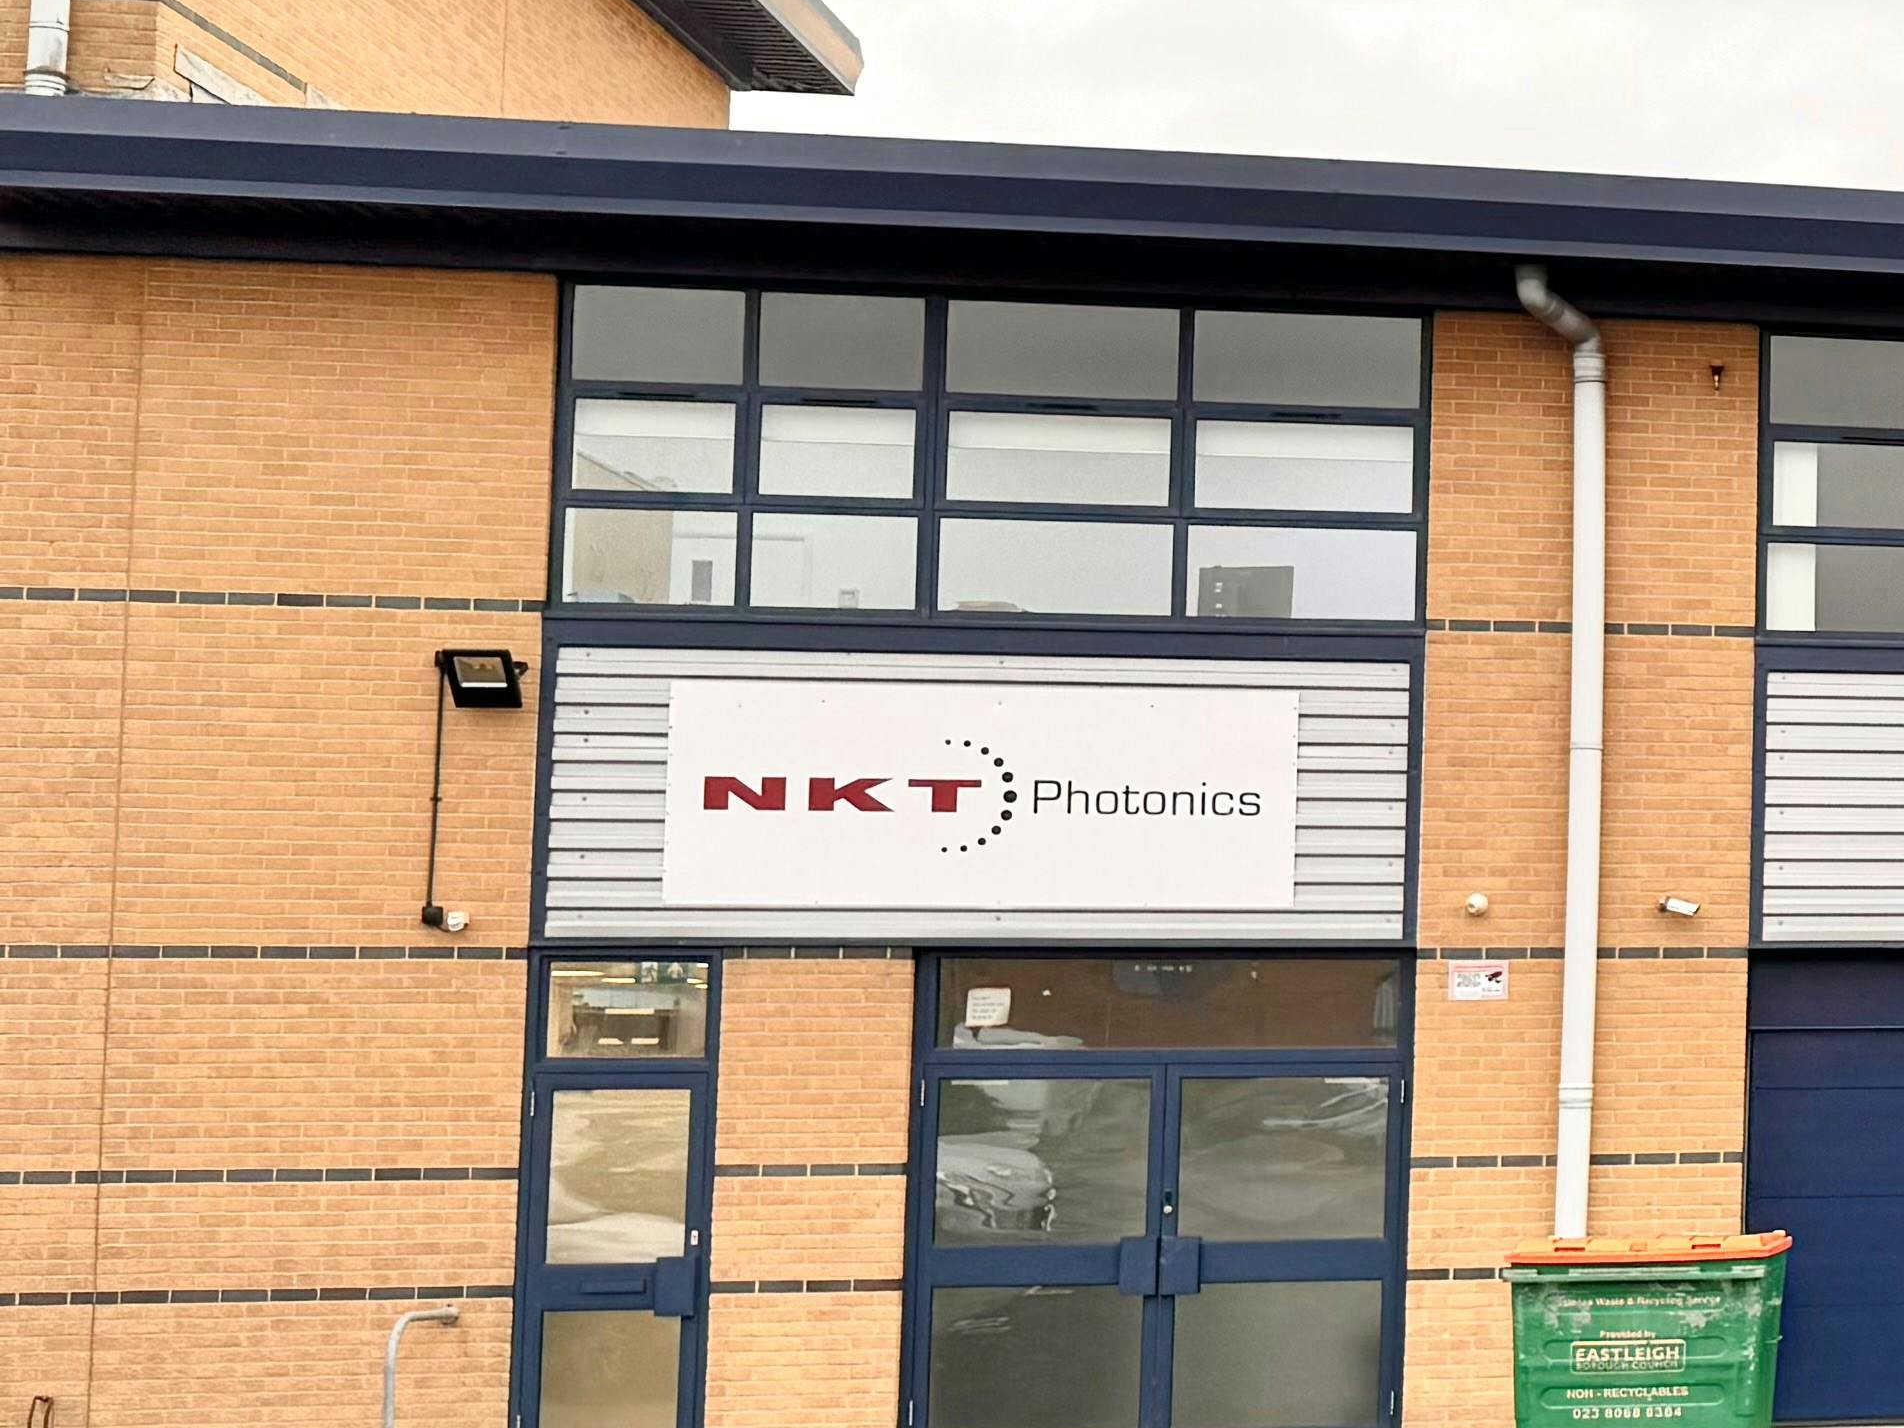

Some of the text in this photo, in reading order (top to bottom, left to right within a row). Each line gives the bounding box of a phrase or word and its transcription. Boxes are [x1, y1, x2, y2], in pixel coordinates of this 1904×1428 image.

[702, 775, 1261, 817] NKT Photonics
[1575, 1346, 1680, 1362] EASTLEIGH
[1567, 1388, 1594, 1399] NON
[1603, 1386, 1689, 1399] RECYCLABLES
[1572, 1408, 1600, 1419] 023
